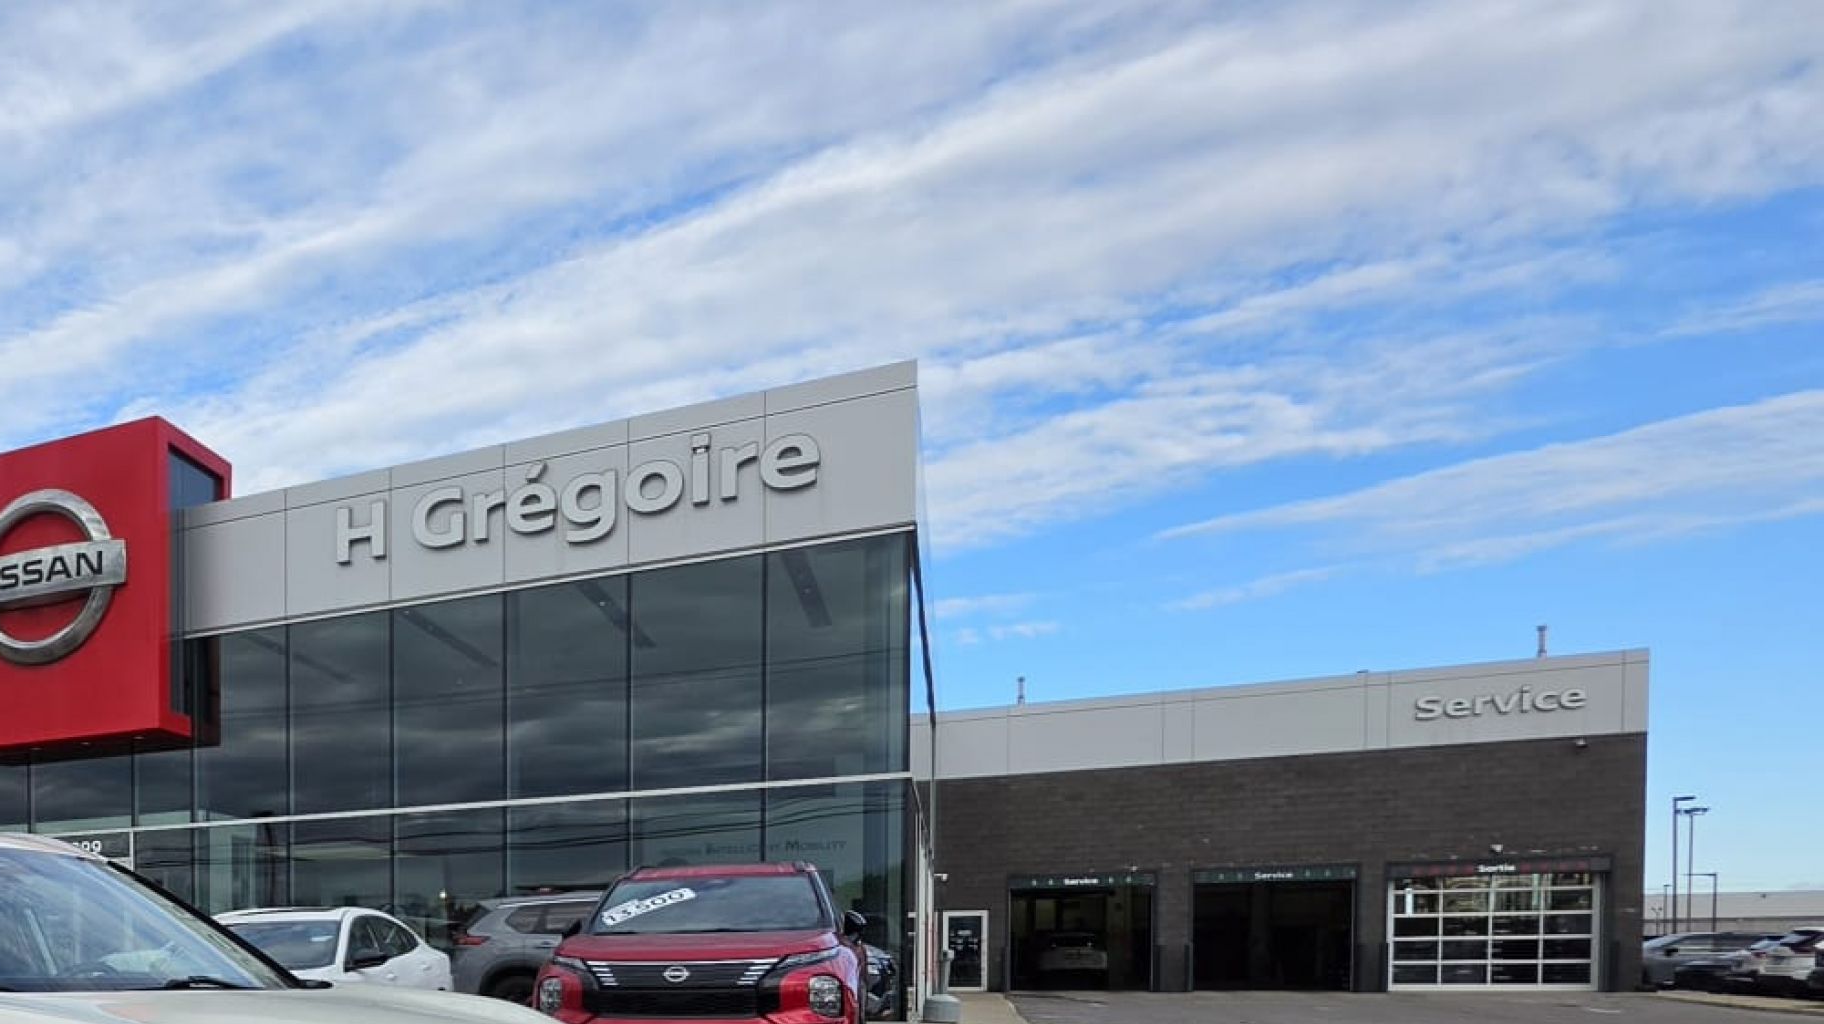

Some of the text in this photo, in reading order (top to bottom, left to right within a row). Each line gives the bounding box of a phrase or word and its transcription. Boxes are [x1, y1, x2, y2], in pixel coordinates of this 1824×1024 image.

[336, 432, 821, 565] H Grégoire
[1415, 684, 1587, 721] Service
